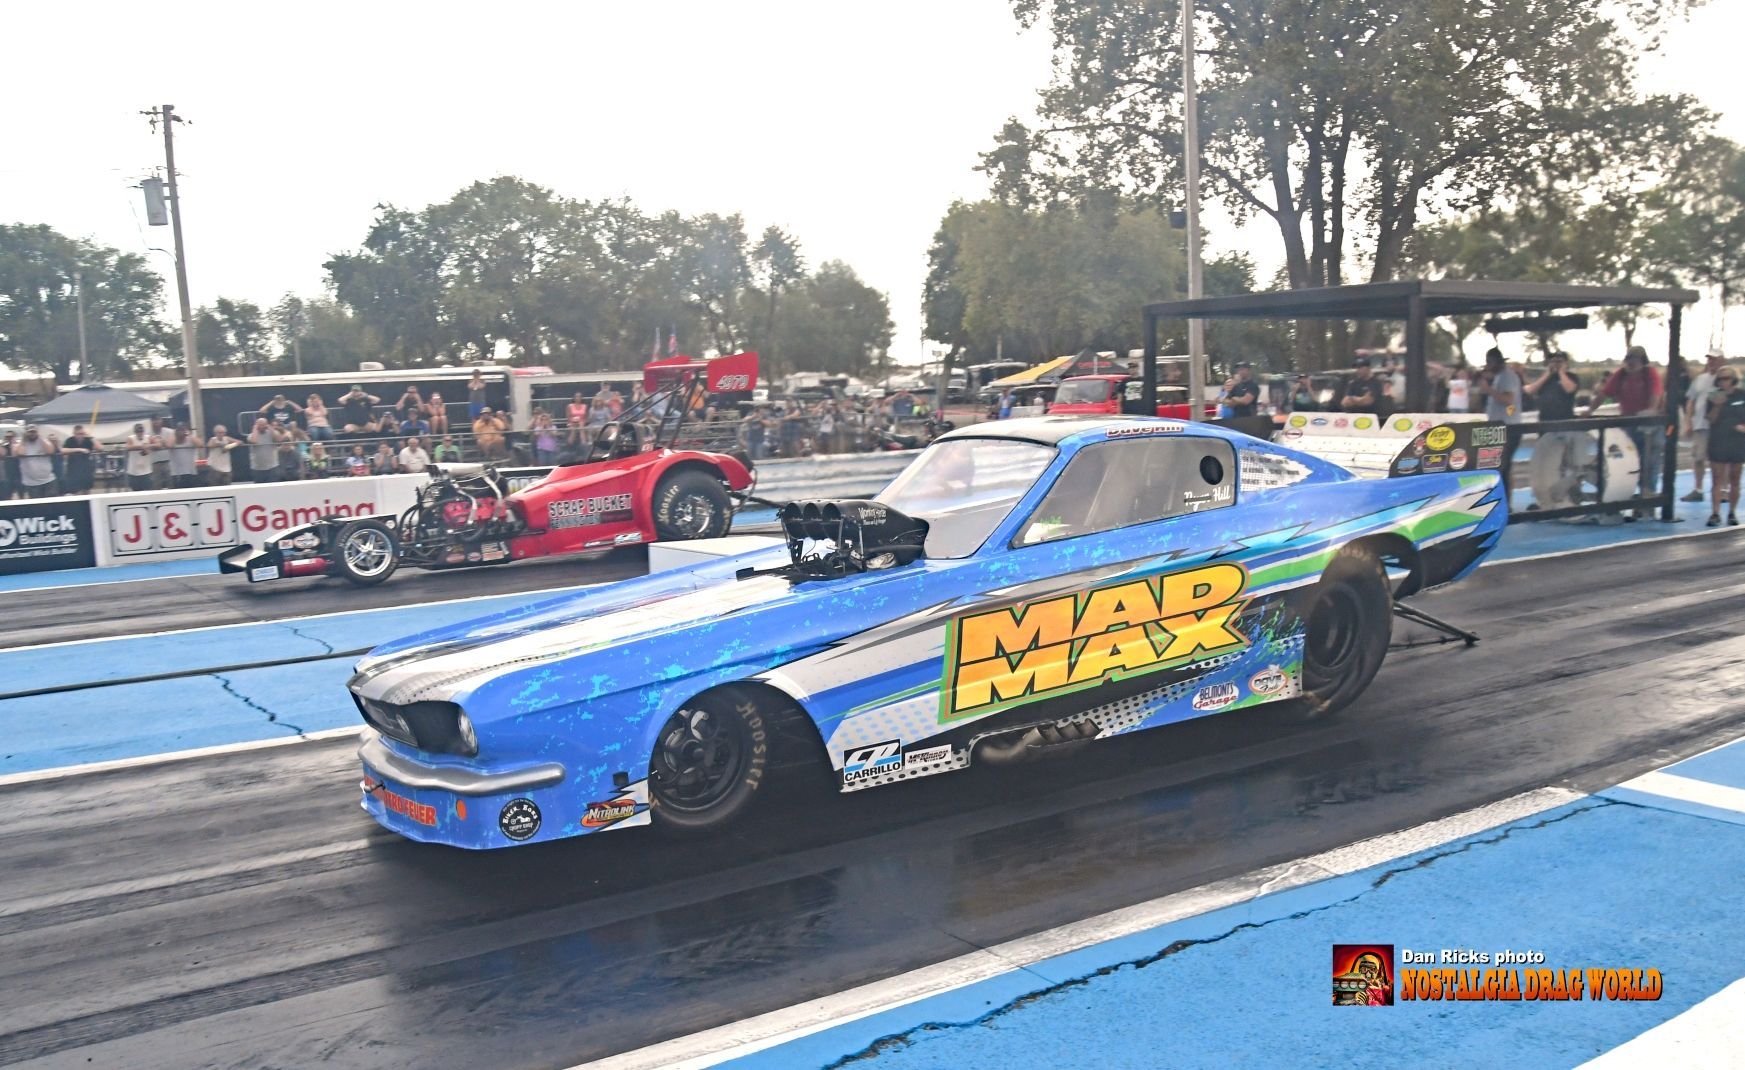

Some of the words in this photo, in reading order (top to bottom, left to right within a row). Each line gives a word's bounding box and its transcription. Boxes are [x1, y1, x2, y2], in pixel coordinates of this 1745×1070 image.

[1212, 486, 1231, 501] Hill
[548, 499, 585, 518] SCRAP
[587, 493, 632, 514] BUCKET
[14, 514, 76, 534] Wick
[123, 514, 143, 544] J
[163, 512, 188, 540] &
[206, 508, 225, 537] J
[958, 564, 1247, 663] MAD
[953, 604, 1246, 713] MAX
[1193, 695, 1239, 709] Garage
[844, 761, 900, 782] CARRILLO
[588, 804, 635, 820] NITROLINK
